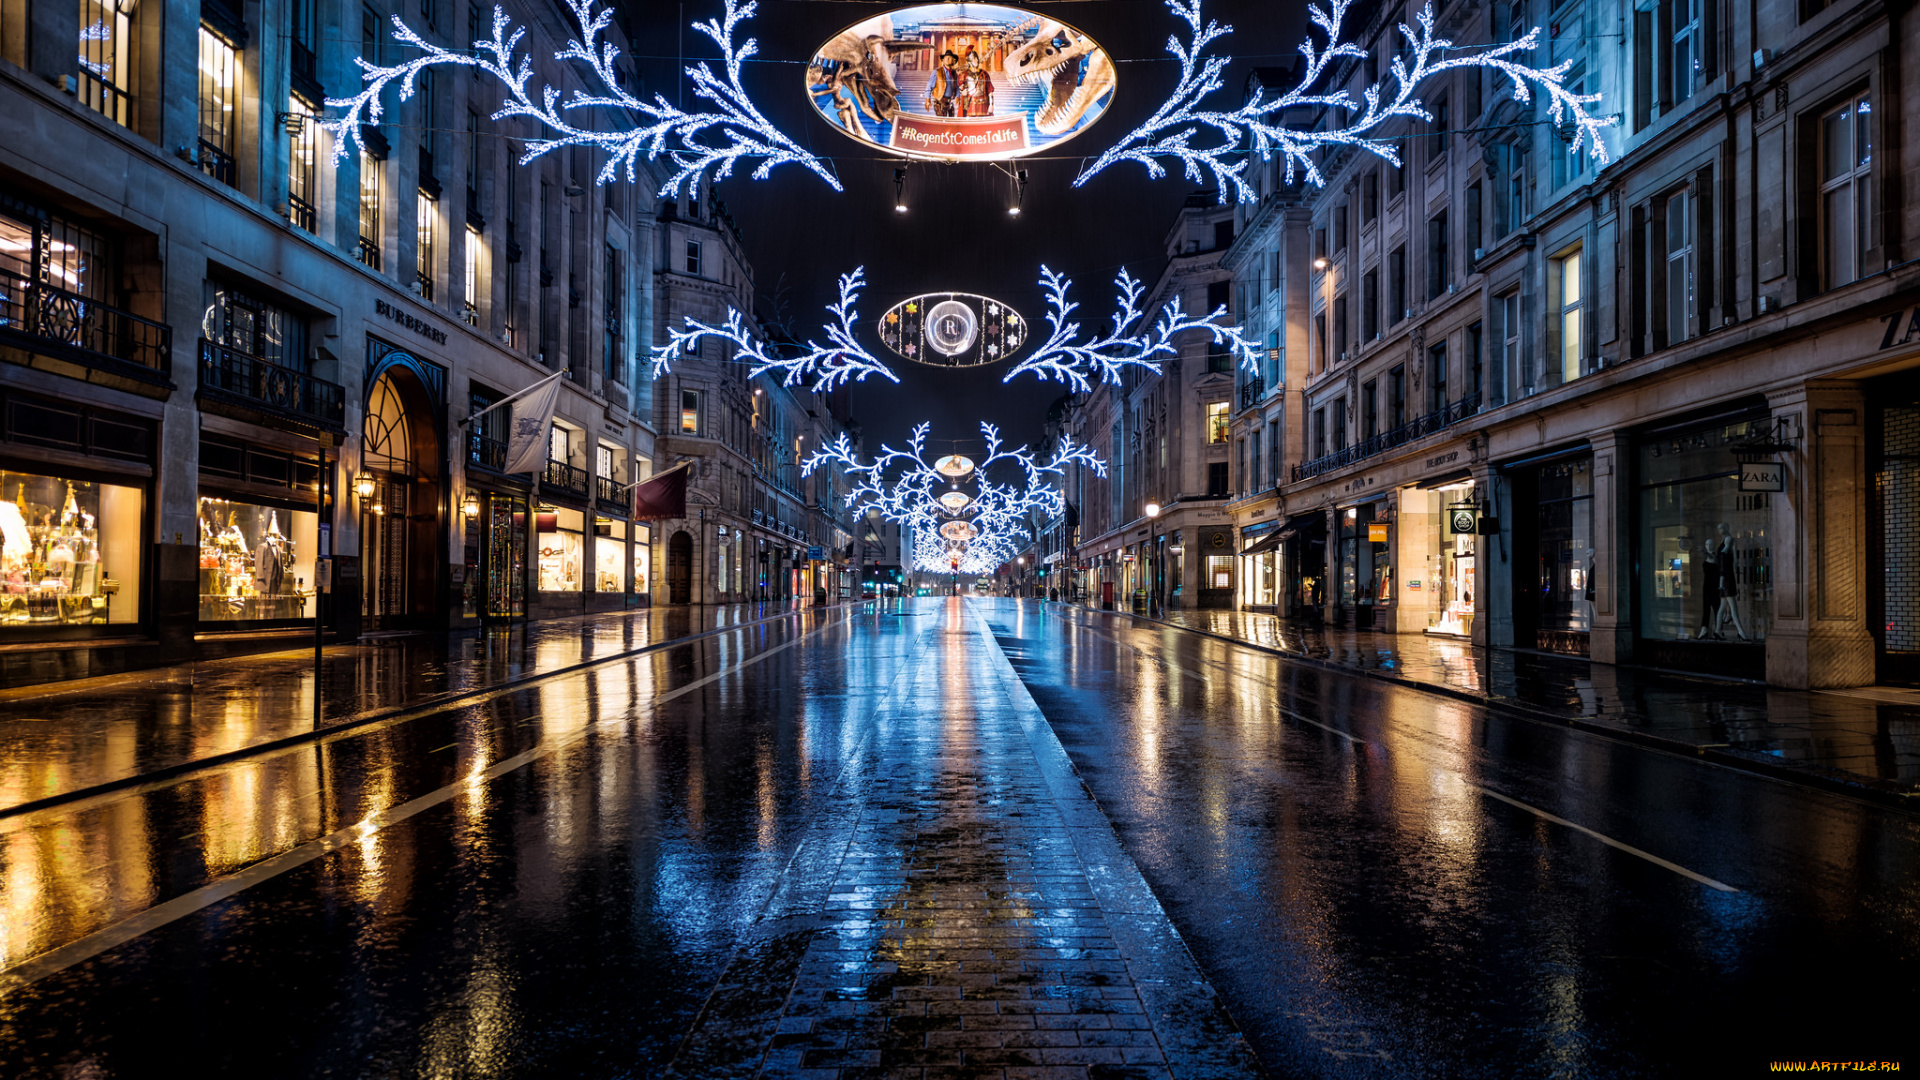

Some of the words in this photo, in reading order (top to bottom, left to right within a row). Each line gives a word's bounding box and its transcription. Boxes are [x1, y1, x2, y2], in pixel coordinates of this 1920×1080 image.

[901, 127, 1018, 147] #RegentStComesToLife
[375, 298, 448, 346] BURBERRY
[946, 319, 957, 336] R
[1879, 305, 1920, 351] ZA
[1741, 471, 1780, 483] ZARA
